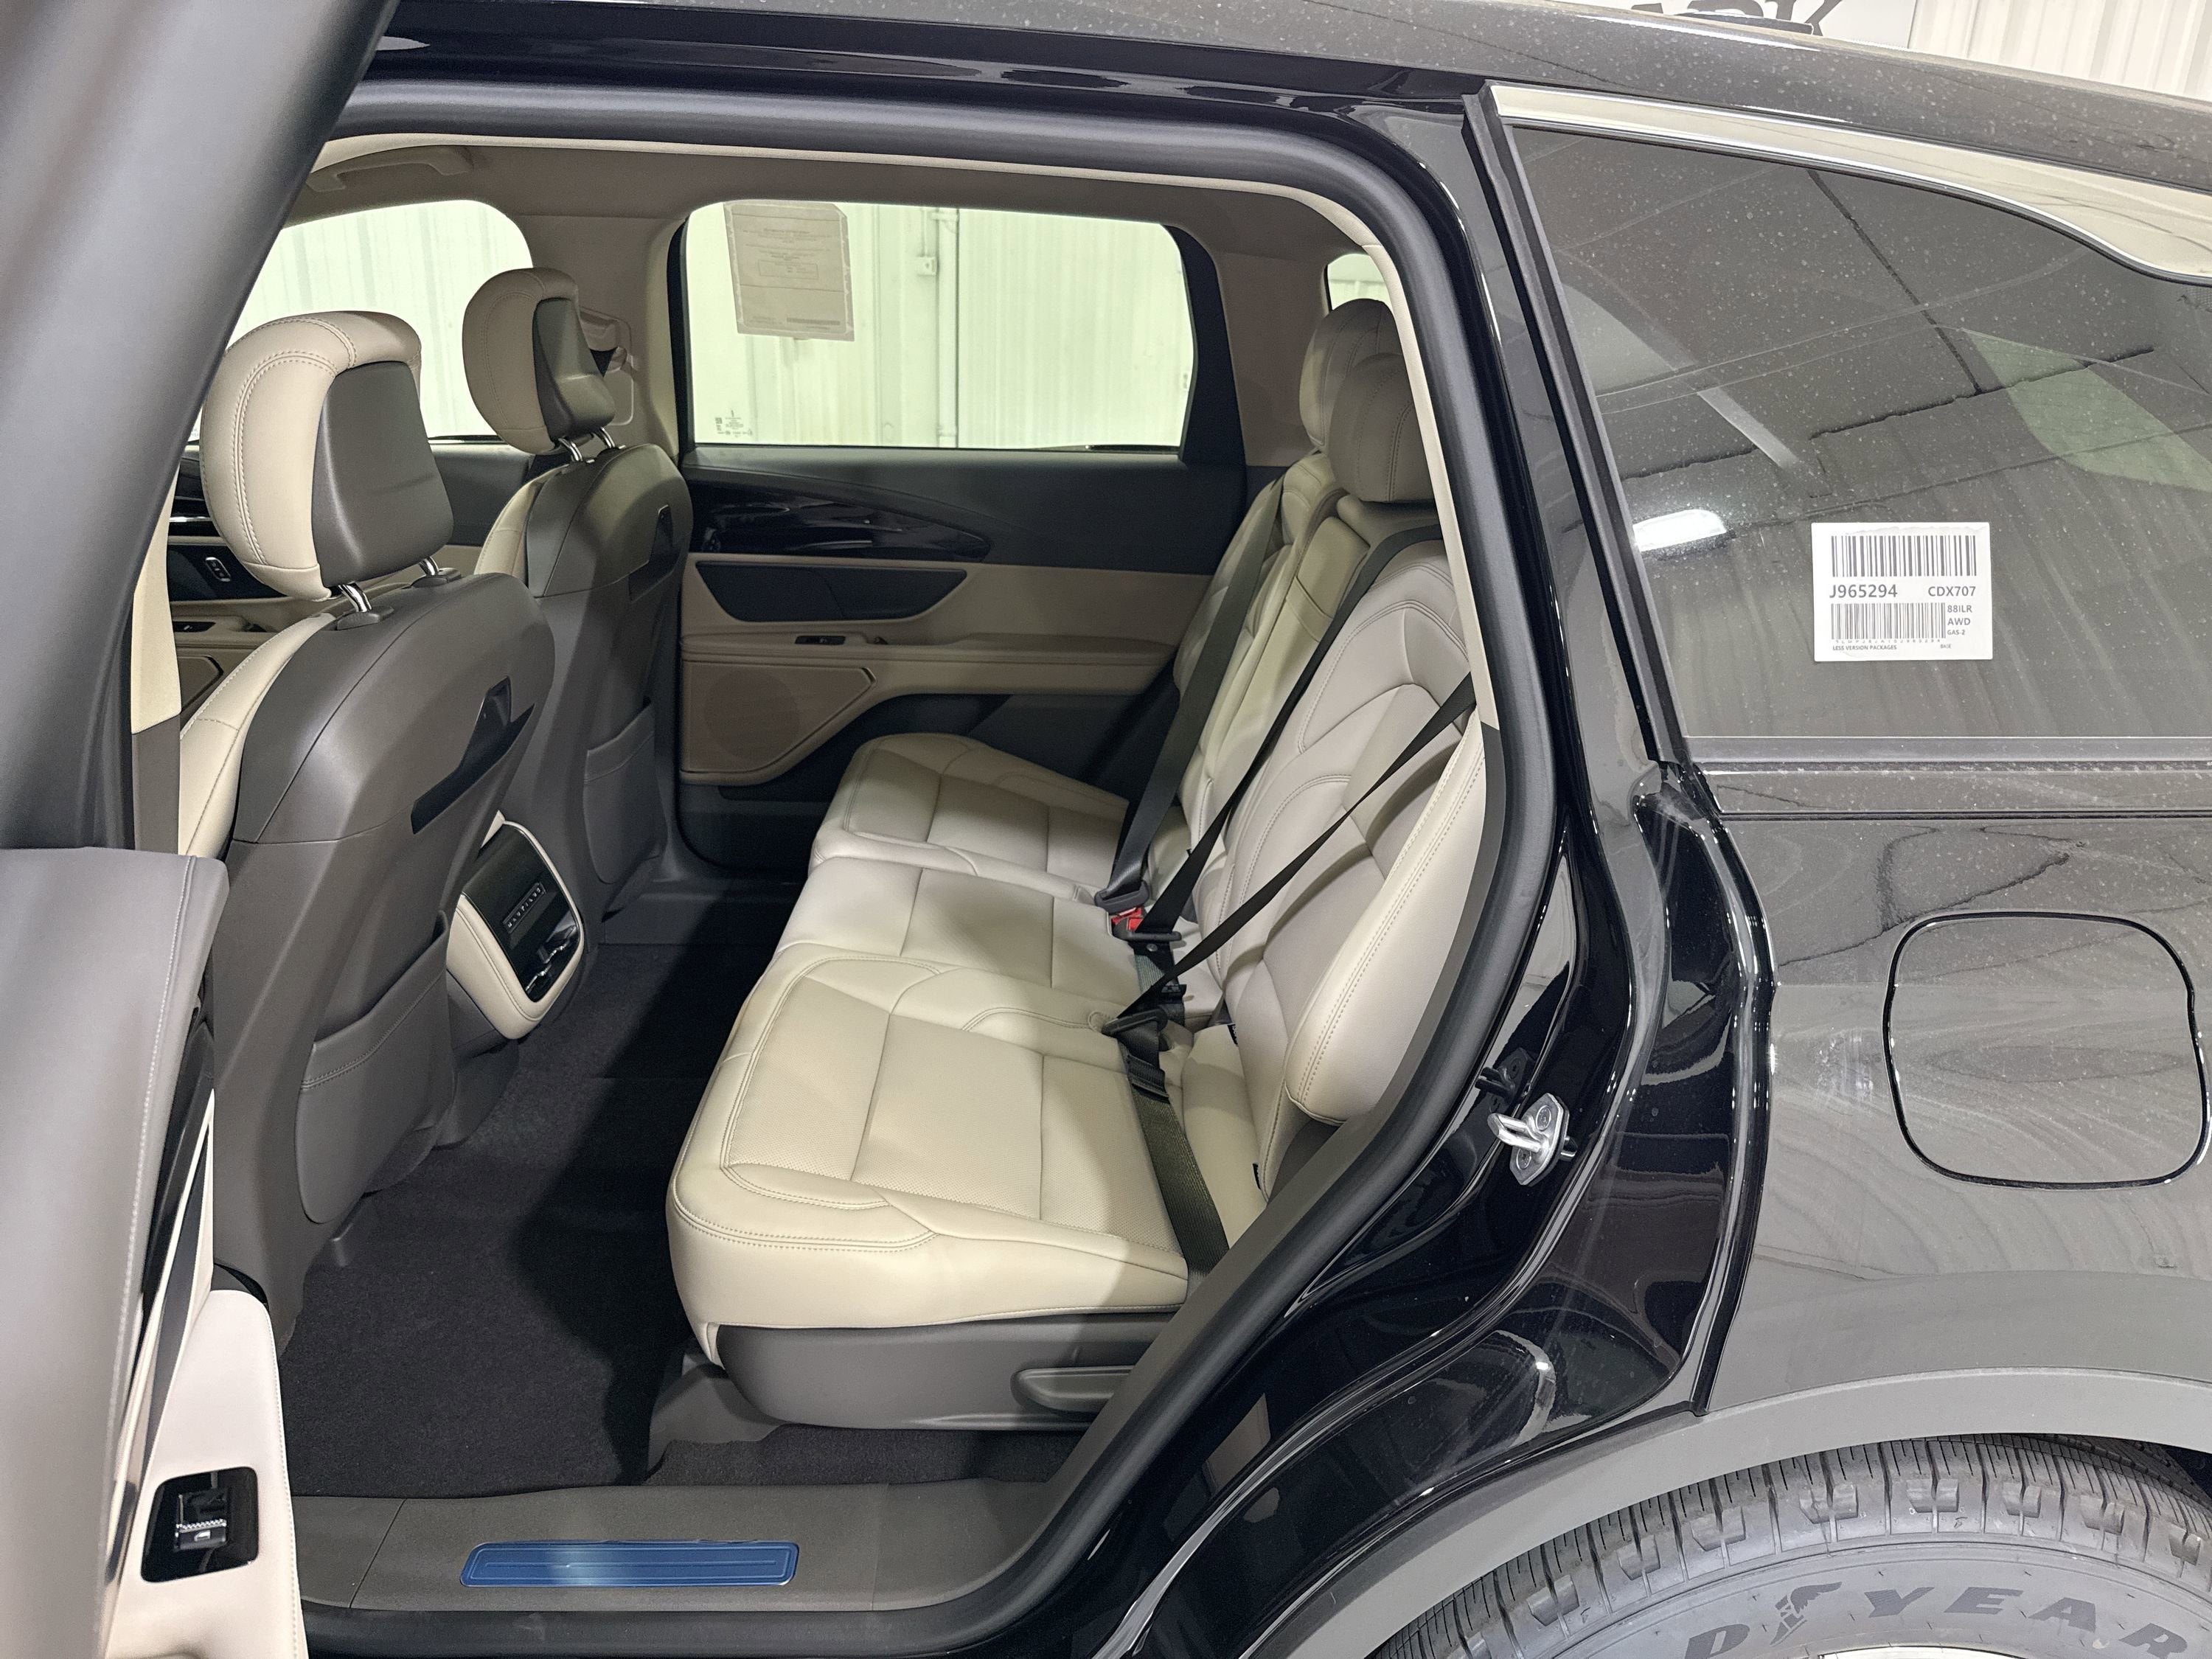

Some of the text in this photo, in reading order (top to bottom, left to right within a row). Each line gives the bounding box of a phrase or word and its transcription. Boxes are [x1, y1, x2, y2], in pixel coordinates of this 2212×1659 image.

[1829, 583, 1976, 598] J965294 CDX707
[1947, 617, 1971, 626] AWD
[507, 887, 541, 928] NAUTILUS
